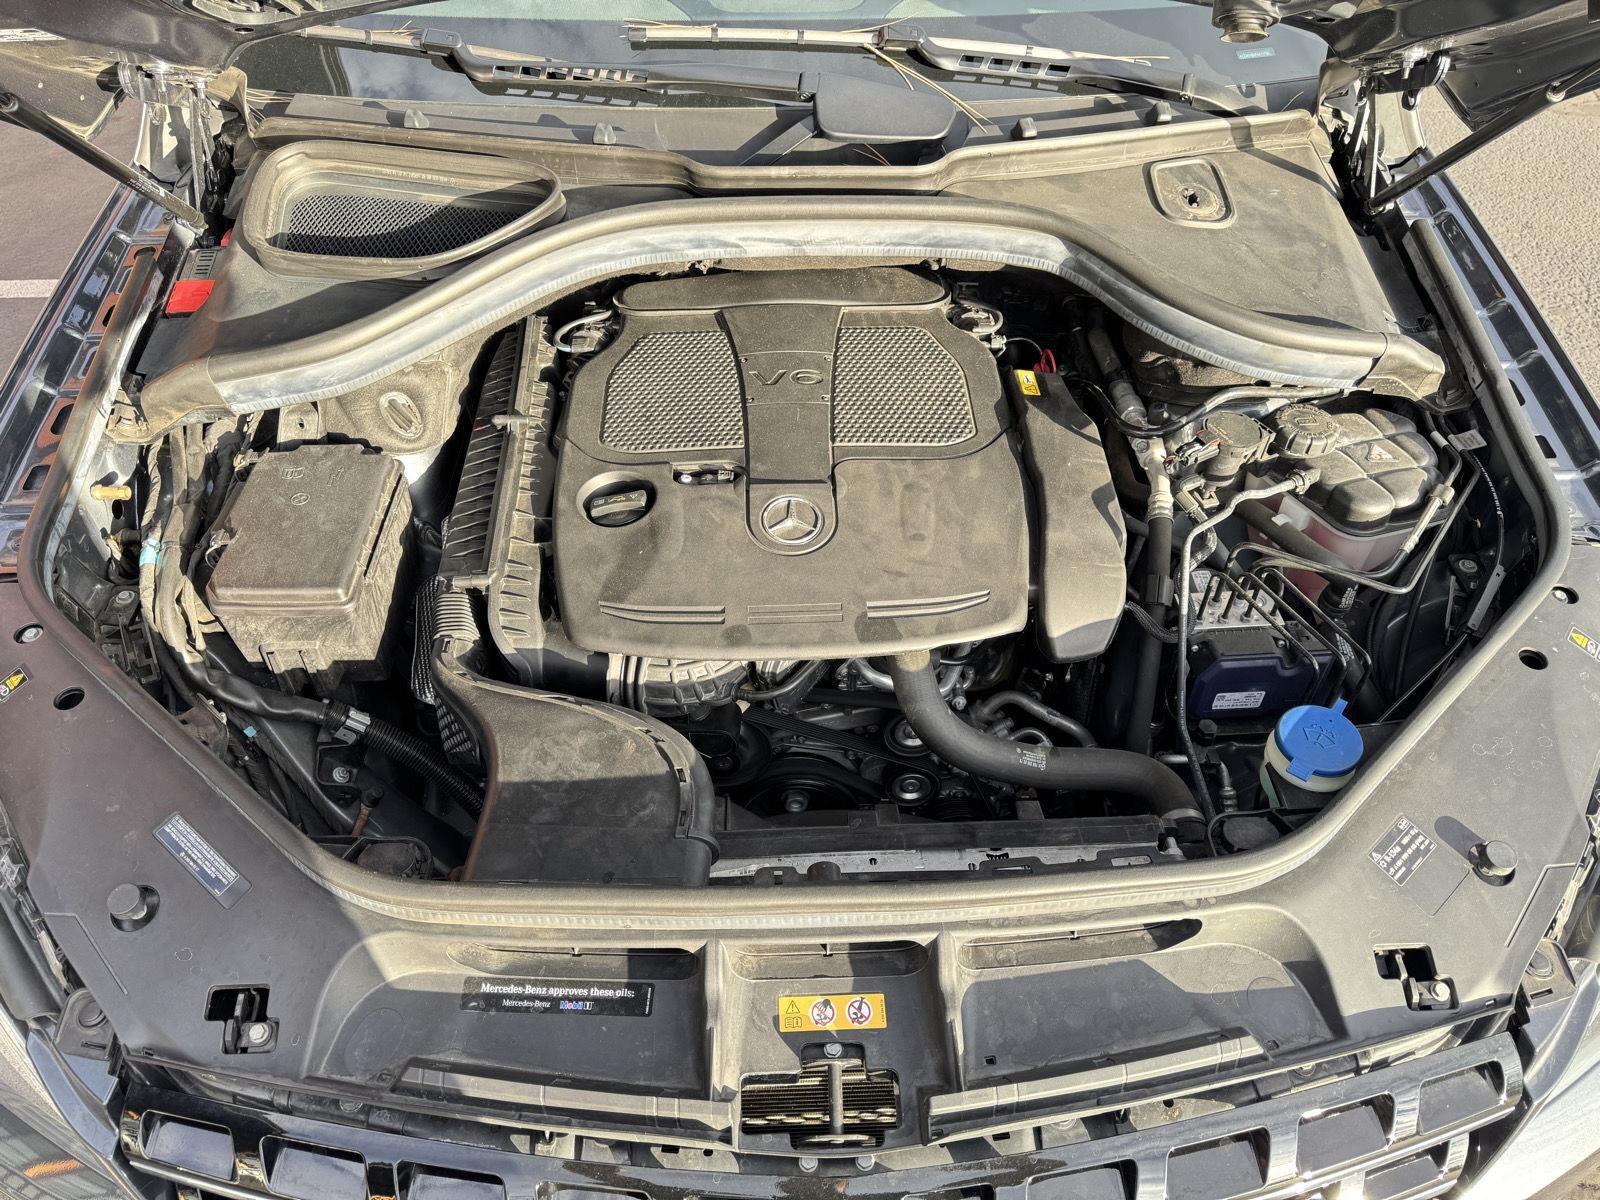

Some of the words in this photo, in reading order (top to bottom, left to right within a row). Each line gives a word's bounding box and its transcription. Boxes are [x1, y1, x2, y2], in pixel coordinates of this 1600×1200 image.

[749, 369, 823, 386] V6
[480, 982, 547, 995] Mercedes-Benz
[548, 987, 588, 997] approves
[590, 986, 614, 997] these
[615, 988, 635, 998] oils:
[502, 999, 551, 1008] Mercedes-Benz
